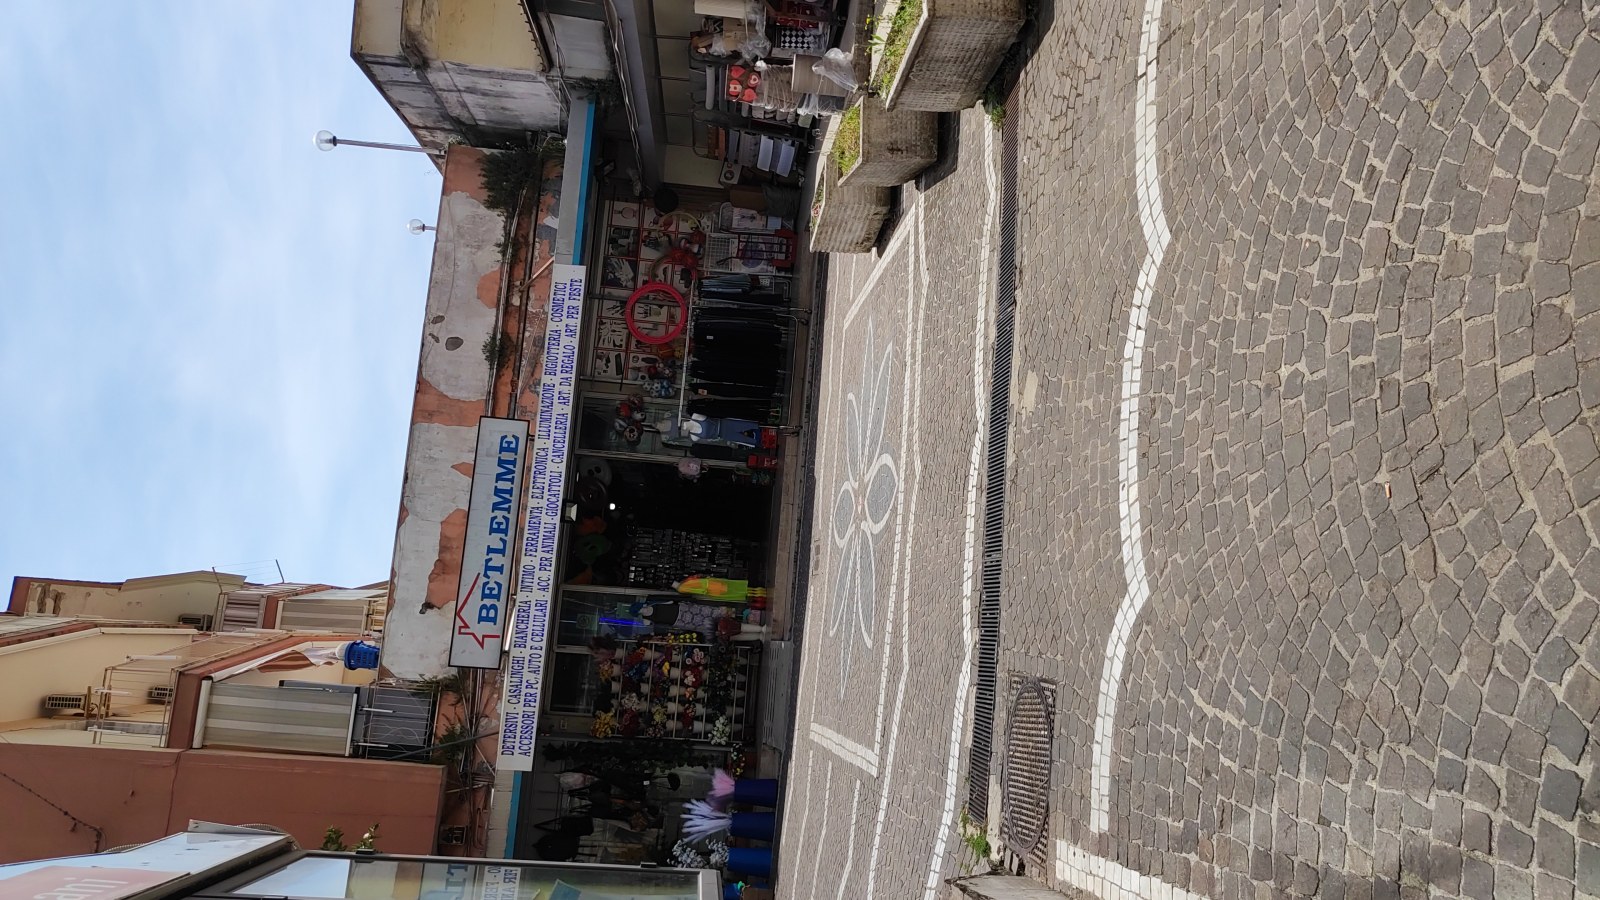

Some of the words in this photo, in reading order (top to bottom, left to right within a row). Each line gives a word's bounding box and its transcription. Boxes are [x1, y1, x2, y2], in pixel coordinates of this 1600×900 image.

[551, 282, 567, 322] COSMETICI
[568, 279, 582, 301] FESTE
[565, 322, 578, 338] ART.
[568, 305, 580, 319] PER
[544, 330, 561, 376] BIGIOTTERIA
[562, 345, 575, 374] REGALO
[558, 389, 571, 406] ART.
[560, 376, 572, 386] DA
[537, 383, 555, 440] ILLUMINAZIONE
[552, 413, 568, 463] CANCELLERIA
[530, 448, 548, 499] ELETTRONICA
[478, 434, 520, 625] BETLEMME
[525, 506, 543, 557] FERRAMENTA
[542, 522, 557, 554] ANIMALI
[520, 564, 536, 593] INTIMO
[541, 556, 553, 572] PER
[539, 575, 551, 592] ACC.
[515, 600, 531, 648] BIANCHERIA
[533, 599, 548, 642] CELLULARI
[509, 656, 525, 704] CASALINGHI
[529, 653, 542, 675] AUTO
[524, 692, 538, 708] PER
[501, 712, 519, 756] DETERSIVI
[518, 710, 535, 756] ACCESSORI
